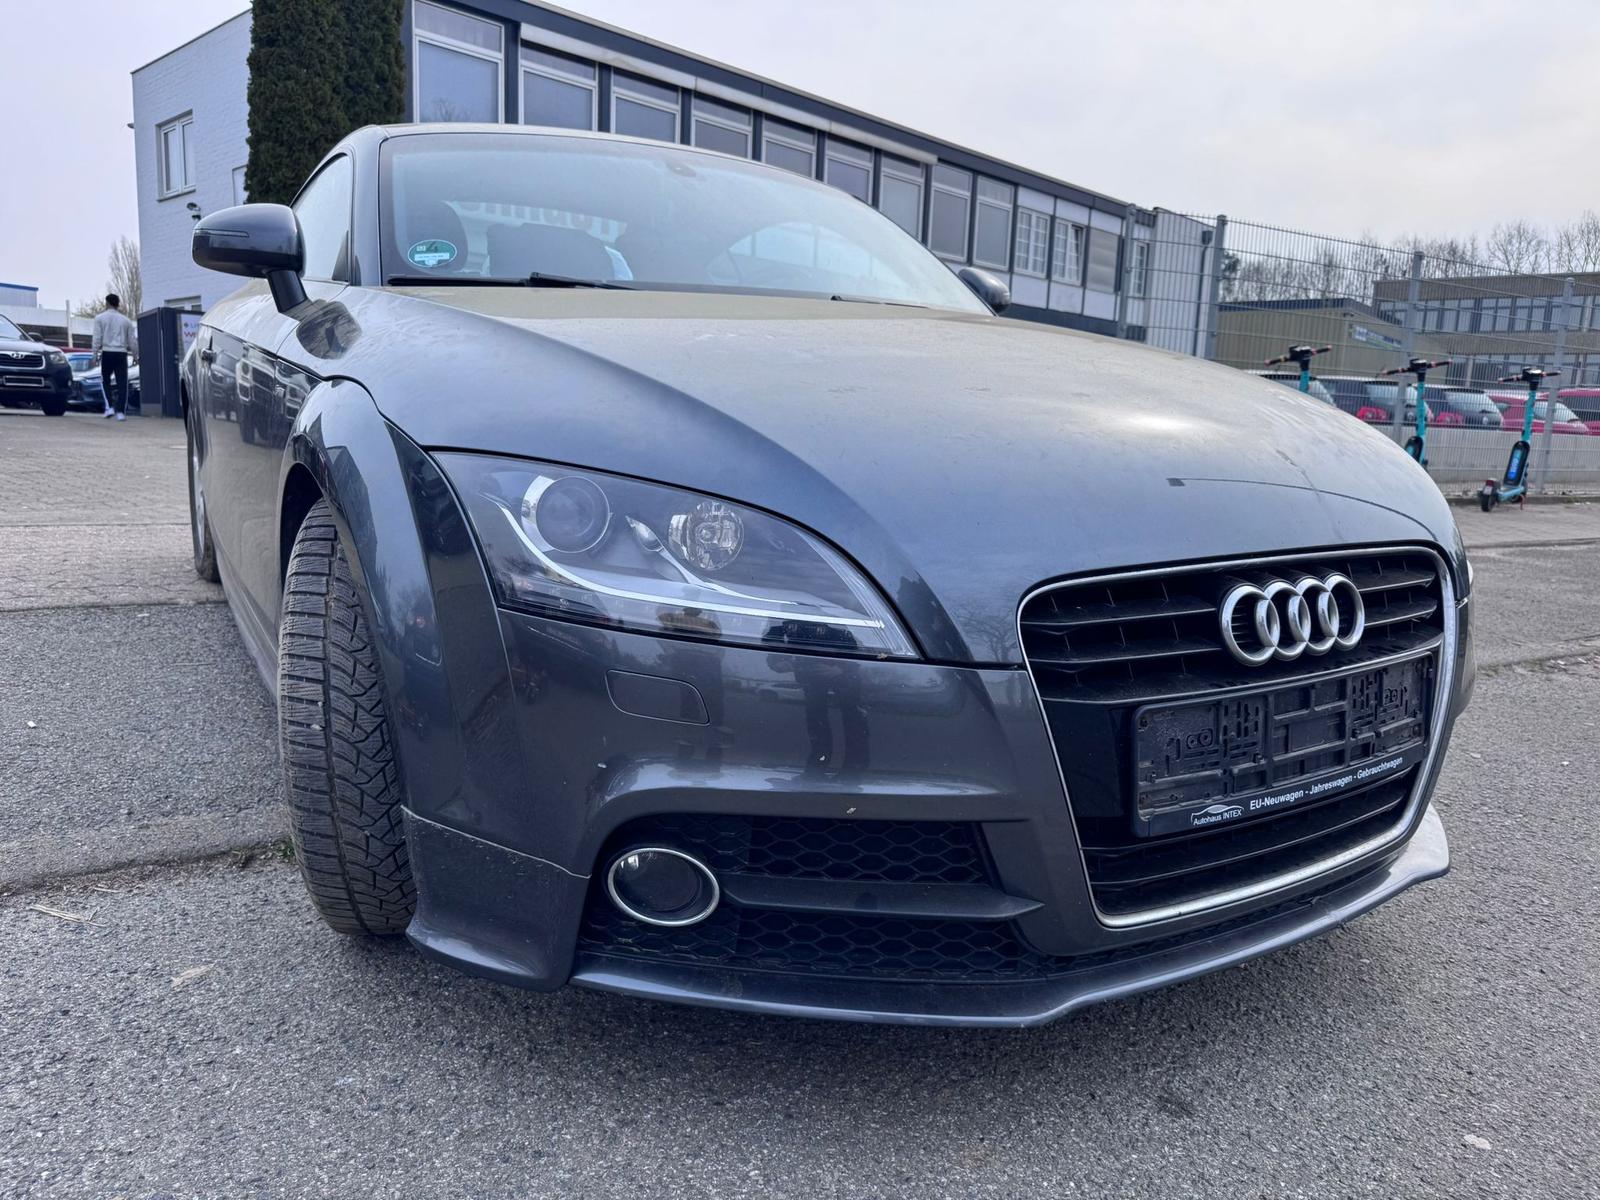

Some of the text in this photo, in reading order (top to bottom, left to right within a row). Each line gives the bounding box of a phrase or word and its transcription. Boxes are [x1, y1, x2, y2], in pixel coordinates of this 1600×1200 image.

[1250, 790, 1304, 810] EU-Neuwagen
[1309, 775, 1353, 795] Jahreswagen
[1357, 757, 1403, 779] Gebrauchtwagen
[1193, 809, 1243, 826] Autohaus INTEX
